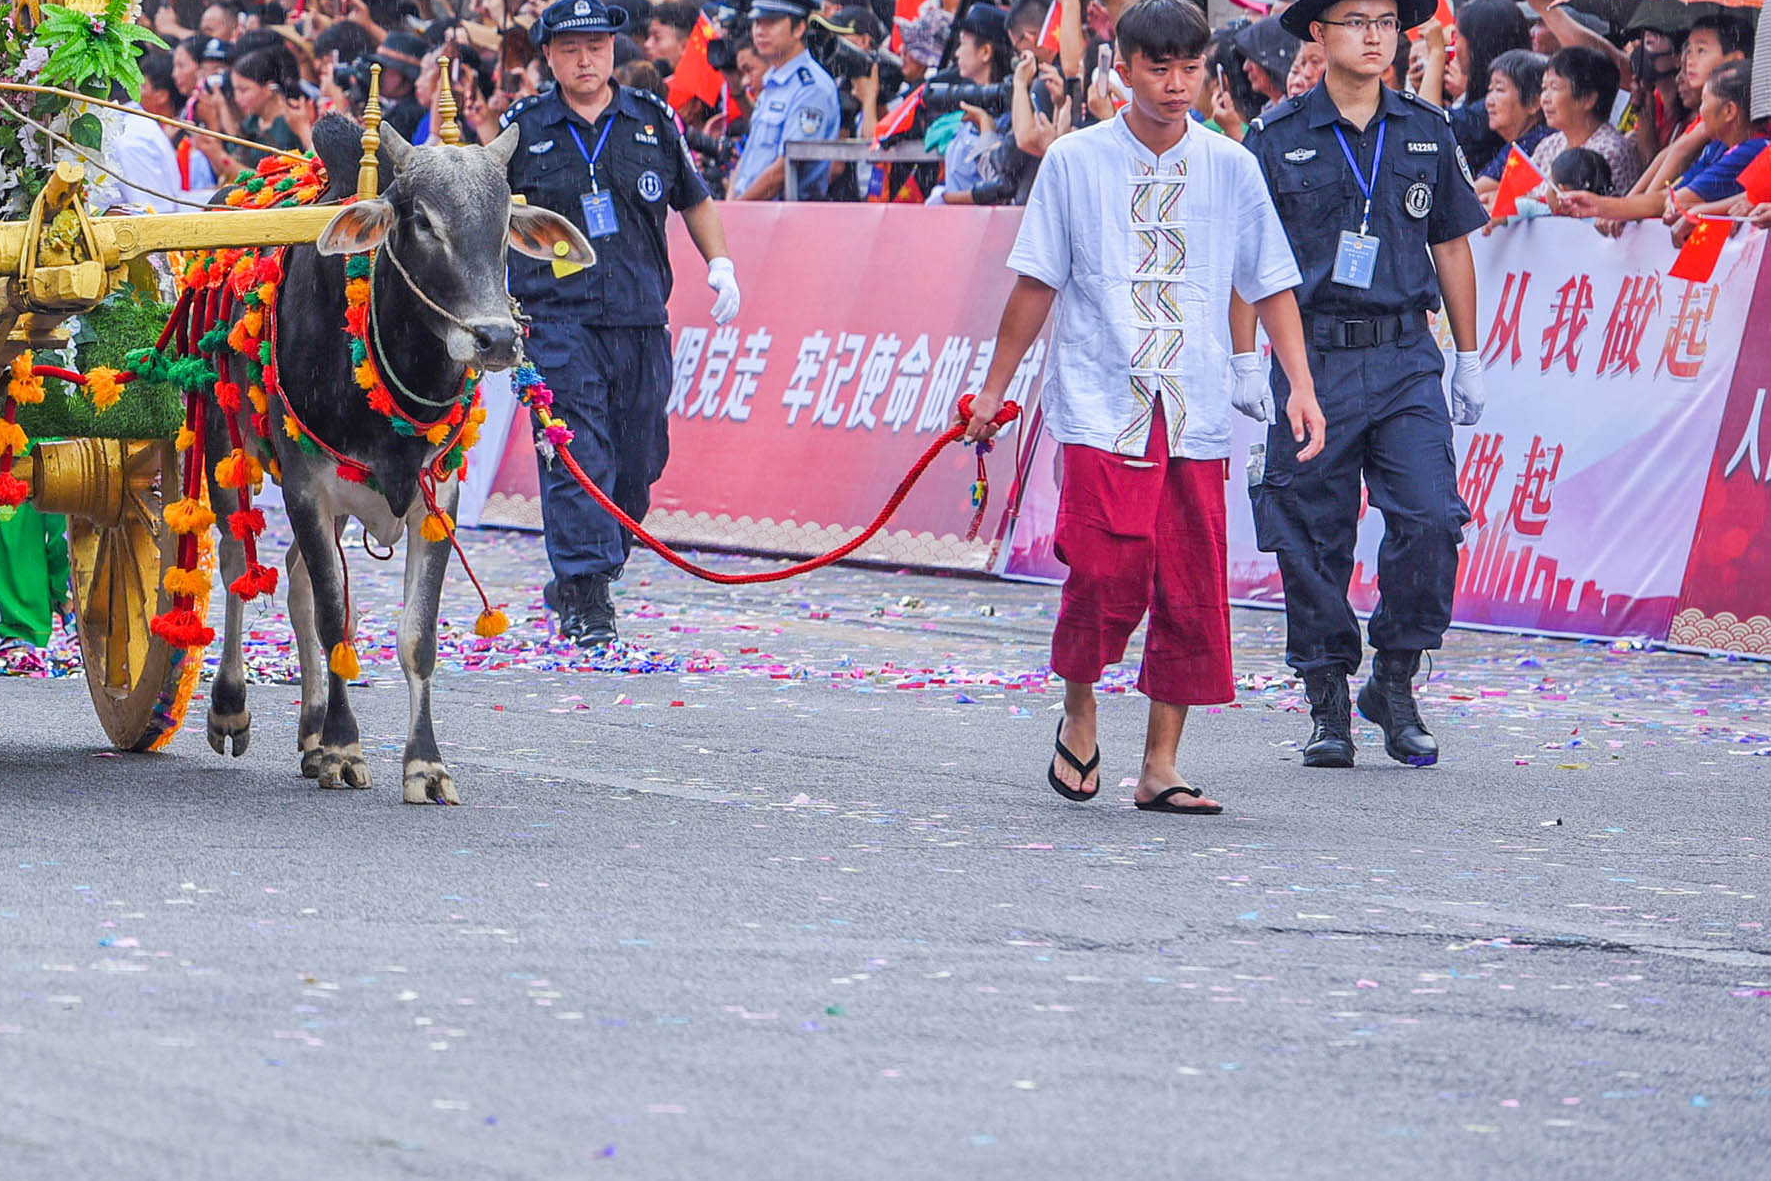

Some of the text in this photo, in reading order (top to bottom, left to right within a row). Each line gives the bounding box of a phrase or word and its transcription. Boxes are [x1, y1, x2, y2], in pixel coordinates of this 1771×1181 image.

[1479, 270, 1721, 381] 从我做起
[1724, 387, 1771, 484] 人
